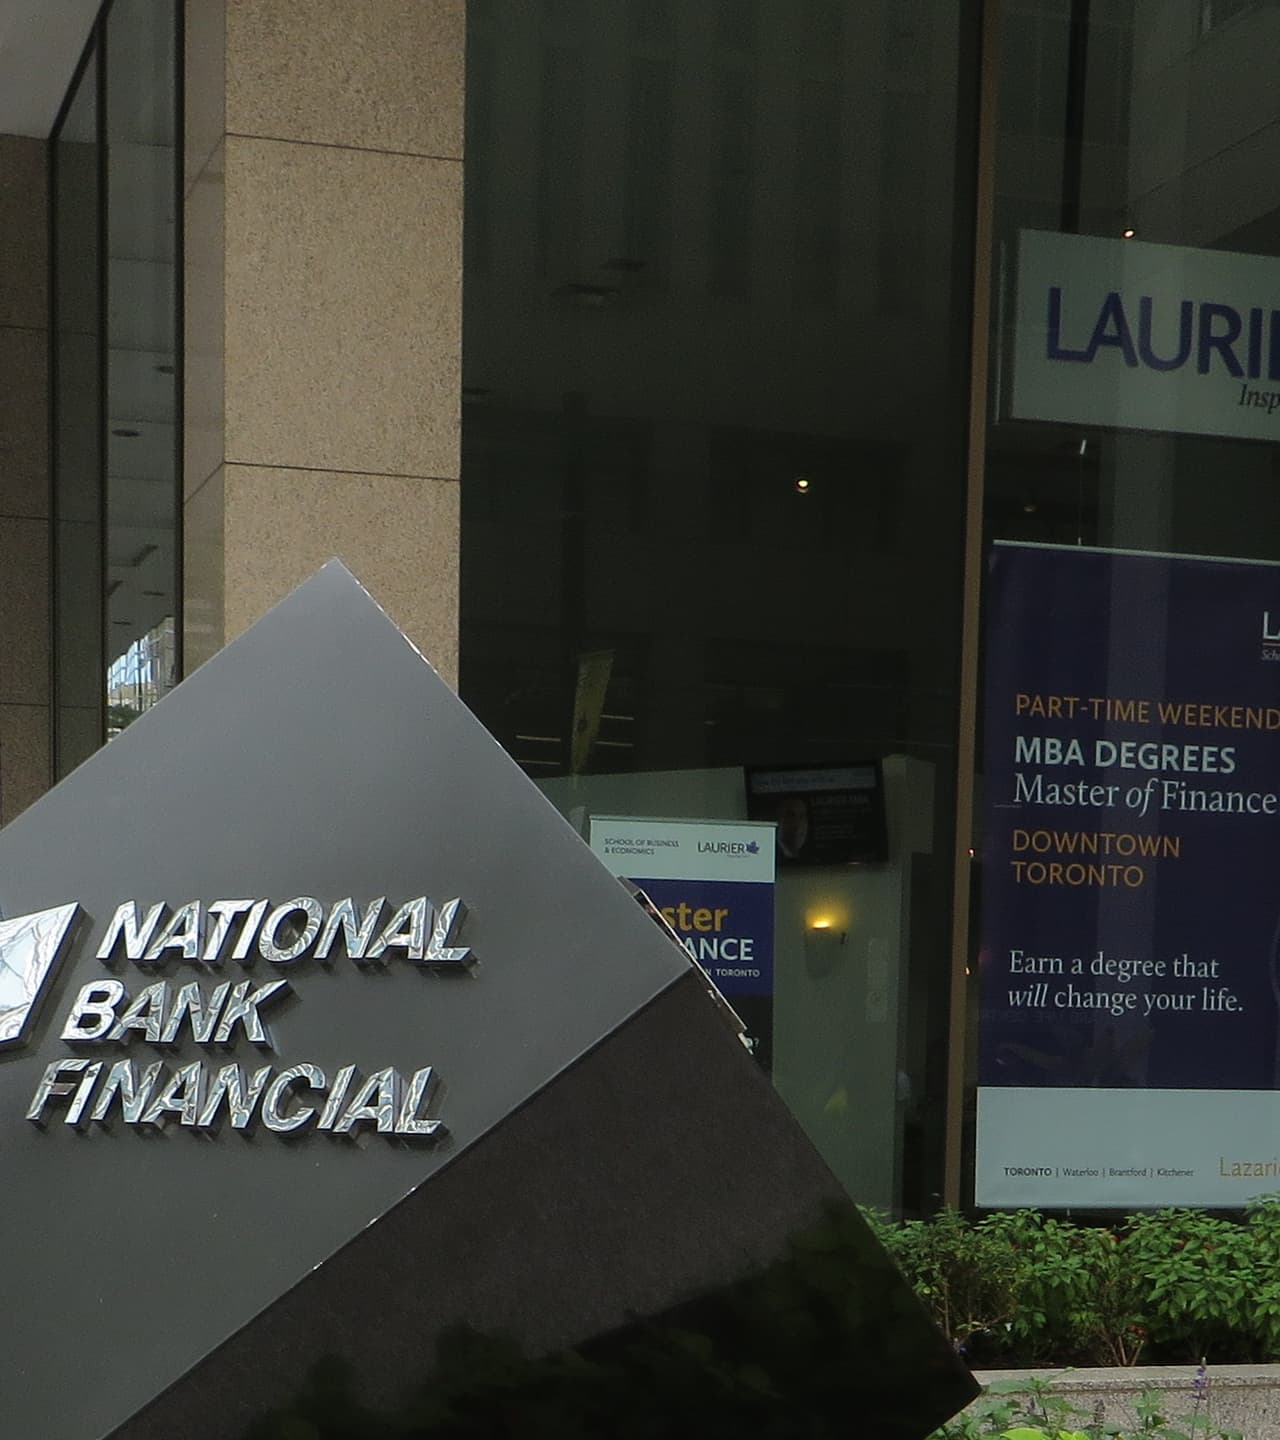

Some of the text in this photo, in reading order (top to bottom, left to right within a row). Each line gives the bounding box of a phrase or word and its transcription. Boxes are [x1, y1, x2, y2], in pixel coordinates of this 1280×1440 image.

[1015, 693, 1151, 724] PART-TIME
[1014, 735, 1236, 774] MBA DEGREES
[1013, 773, 1120, 809] Master
[1125, 777, 1159, 818] of
[1161, 780, 1278, 815] Finance
[604, 838, 634, 846] SCHOOL
[697, 841, 746, 855] LAURIER
[1011, 829, 1181, 859] DOWNTOWN
[1011, 860, 1145, 888] TORONTO
[96, 895, 476, 966] NATIONAL
[716, 968, 761, 978] TORONTO
[1009, 949, 1221, 983] Earn a degree that
[59, 979, 294, 1047] BANK
[1007, 983, 1244, 1016] will change your life.
[25, 1058, 448, 1137] FINANCIAL
[1004, 1166, 1052, 1177] TORONTO
[1062, 1167, 1099, 1177] Waterloo
